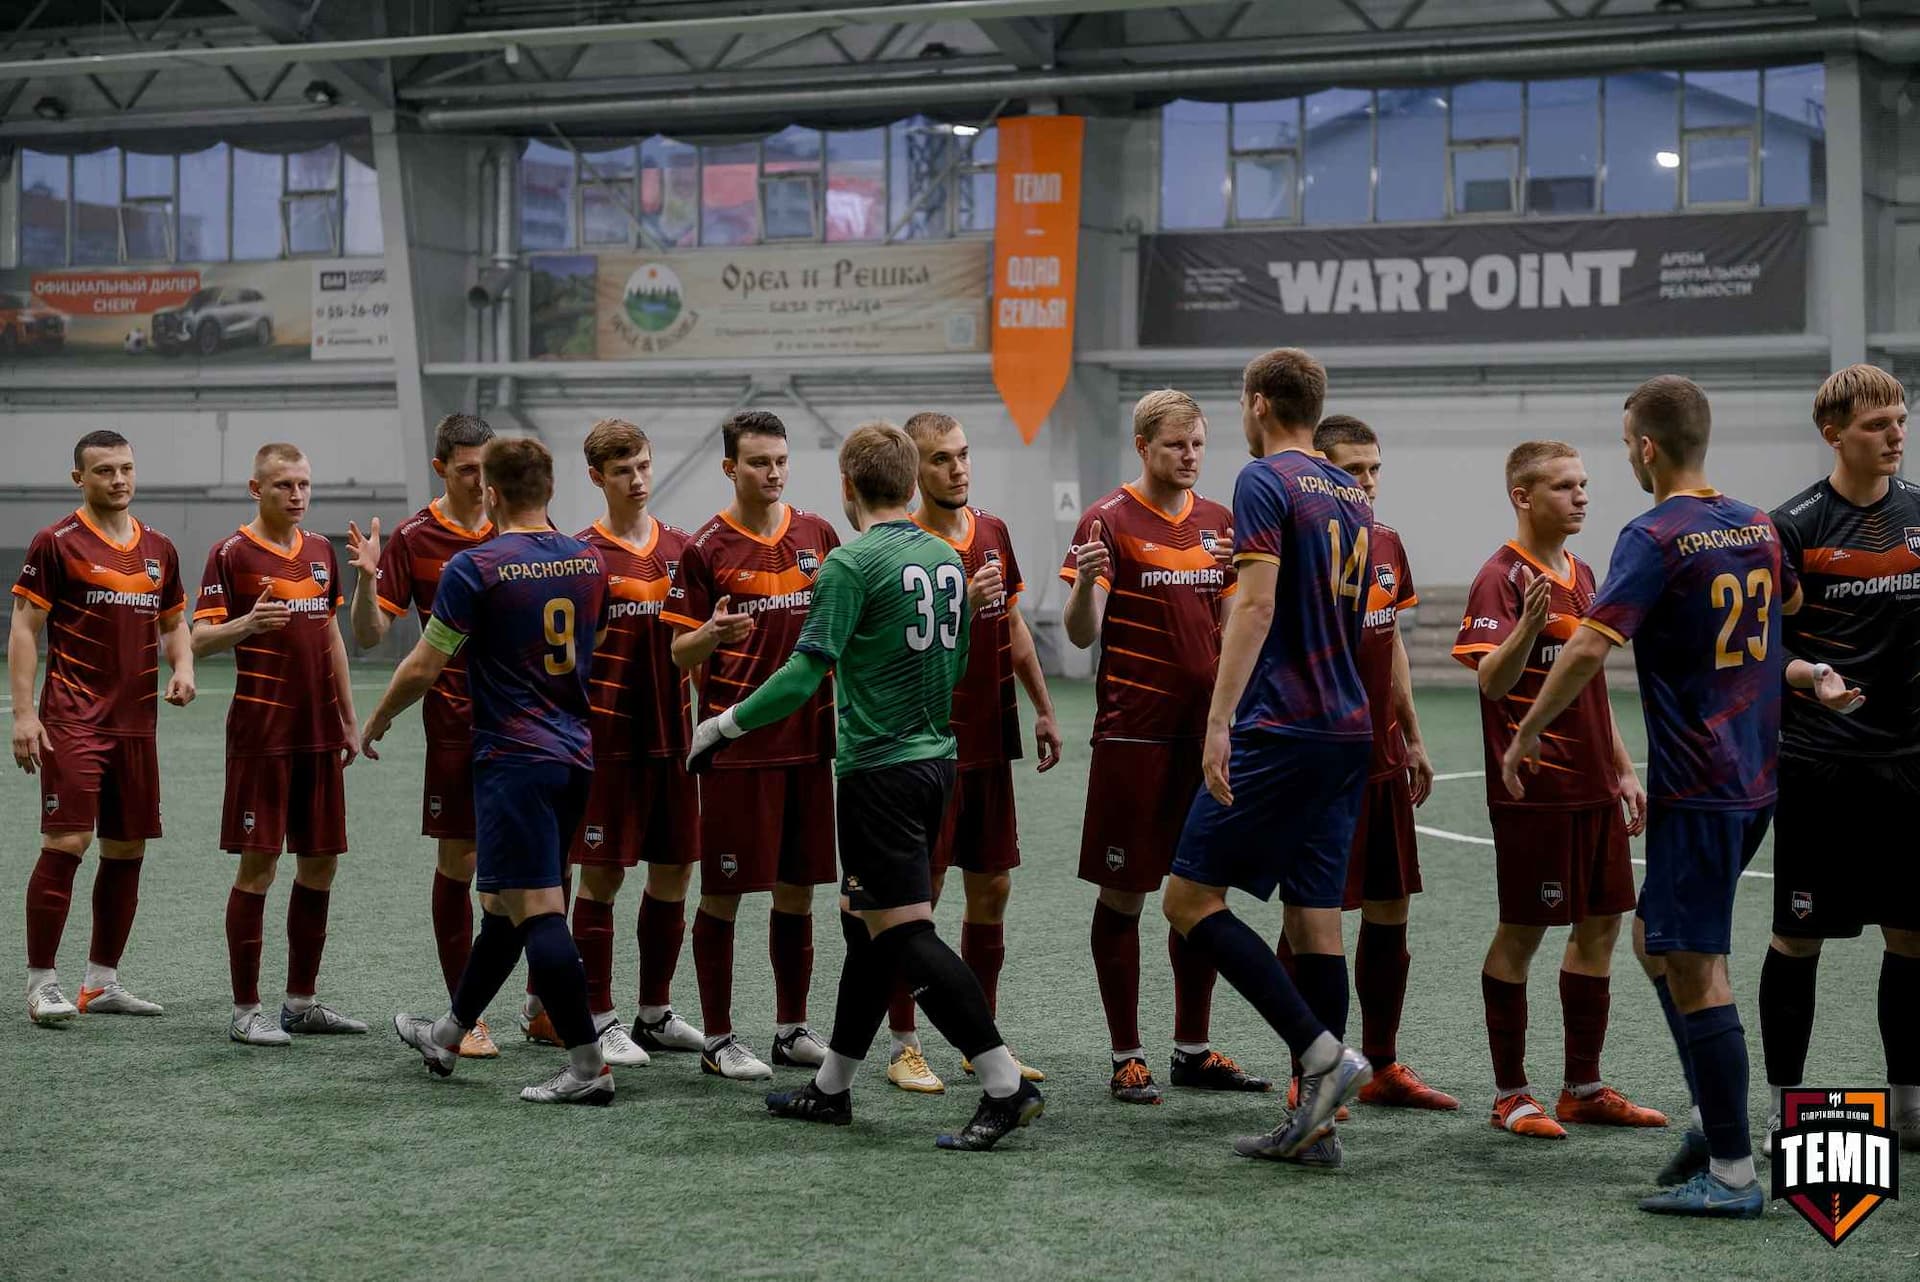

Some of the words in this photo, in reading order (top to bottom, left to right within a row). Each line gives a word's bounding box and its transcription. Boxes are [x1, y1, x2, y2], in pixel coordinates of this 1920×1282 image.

[1013, 173, 1062, 204] ТЕМП
[1660, 251, 1705, 267] АРЕНА
[1008, 256, 1060, 290] ОДНА
[1660, 263, 1760, 283] ВИРТУАЛЬНОЙ
[34, 277, 147, 295] ОФИЦИАЛЬНЫЙ
[149, 275, 198, 294] ДИЛЕР
[1659, 281, 1753, 299] РЕАЛЬНОСТИ
[93, 299, 137, 313] CHERY
[1677, 524, 1774, 557] КРАСНОЯРСК
[23, 564, 38, 577] СБ
[497, 558, 600, 582] КРАСНОЯРСК
[799, 557, 819, 571] ТЕМП
[1327, 518, 1368, 613] 14
[86, 591, 161, 609] ПРОДИНВЕС
[669, 586, 685, 599] СБ
[902, 564, 964, 651] 33
[1473, 616, 1499, 630] ПСБ
[1711, 568, 1773, 670] 23
[543, 597, 576, 676] 9
